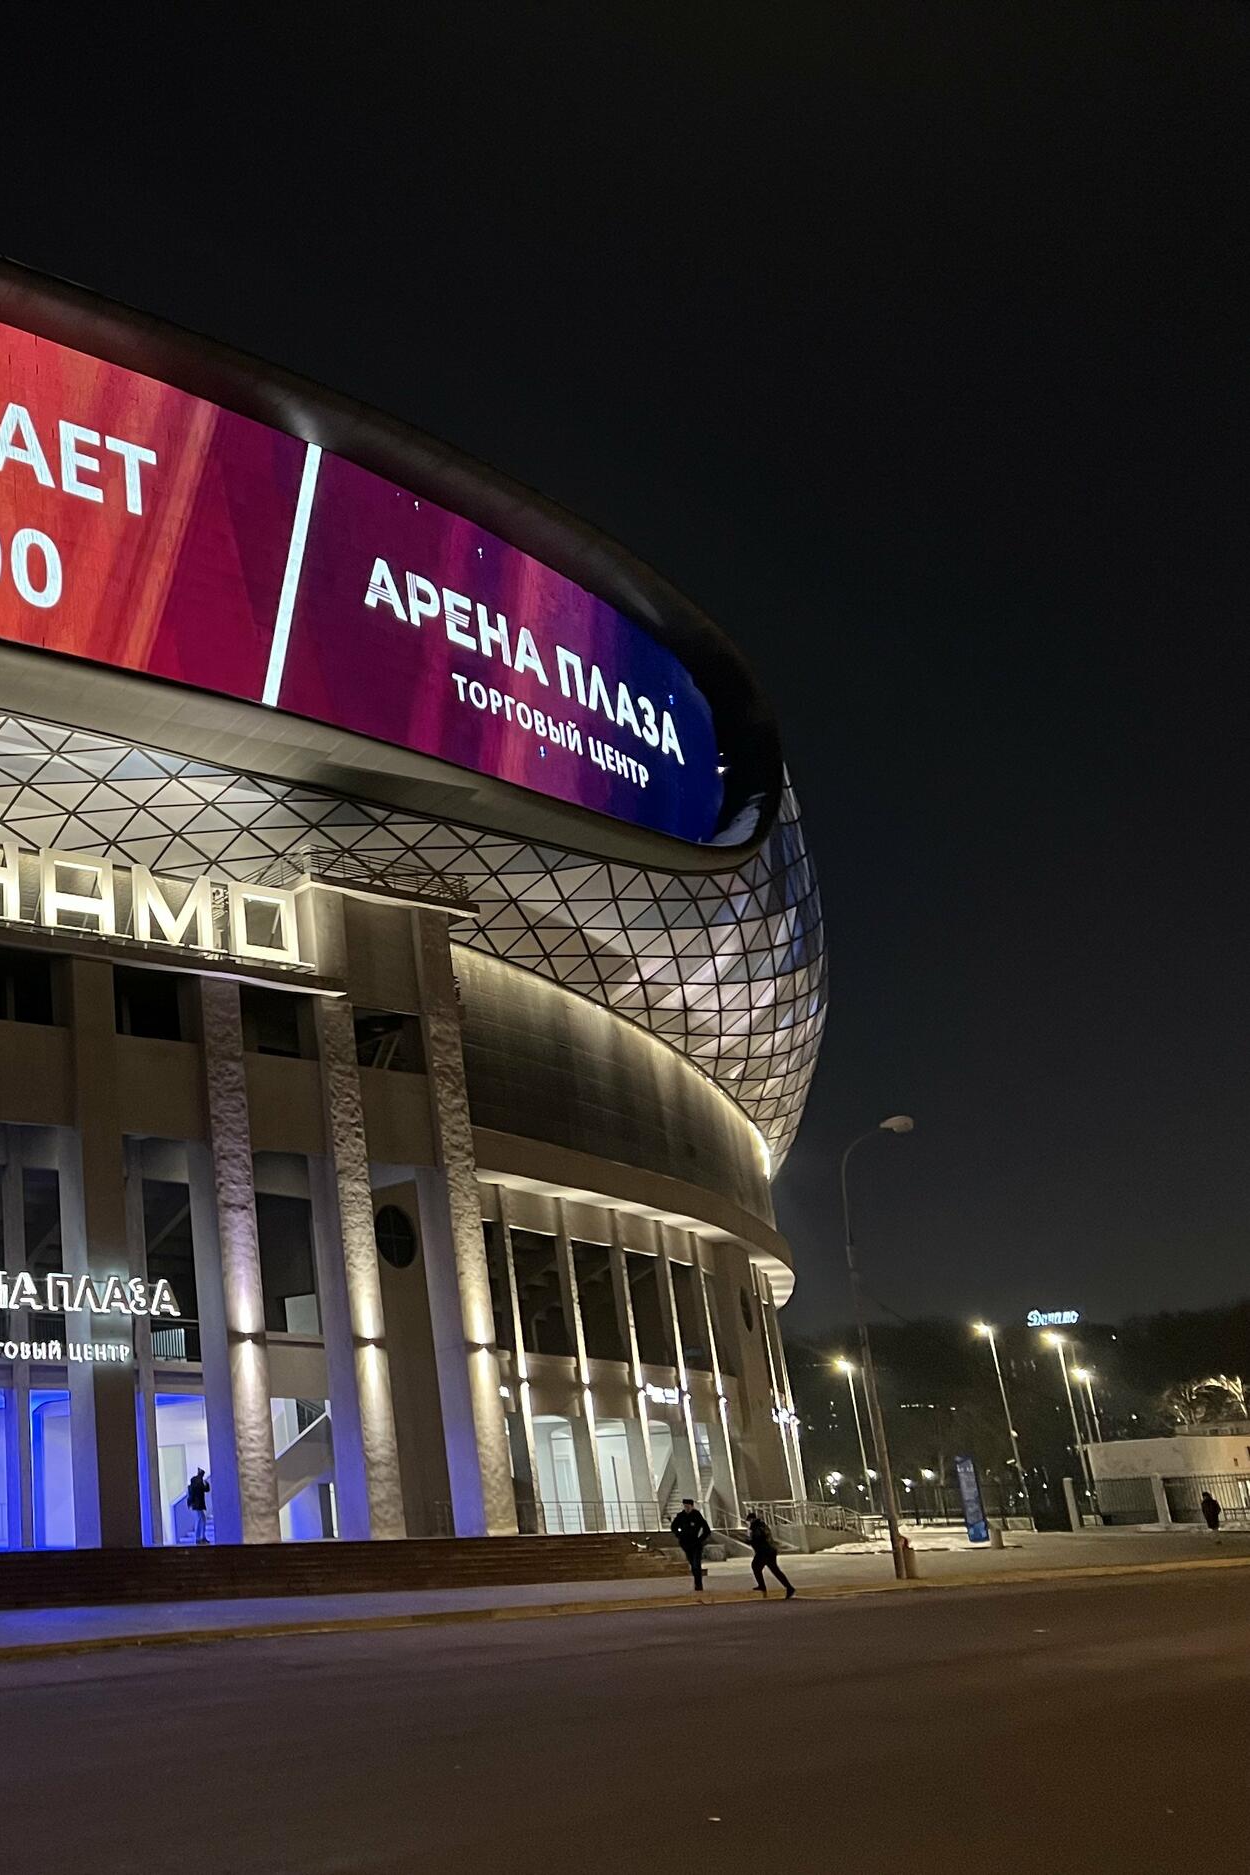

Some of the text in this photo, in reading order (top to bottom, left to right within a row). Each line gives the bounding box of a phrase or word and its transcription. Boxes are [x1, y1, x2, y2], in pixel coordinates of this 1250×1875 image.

[365, 557, 685, 765] АРЕНА ПЛАЗА
[451, 672, 649, 788] ТОРГОВЫЙ ЦЕНТР
[46, 1272, 181, 1317] ПЛАЗА
[68, 1342, 130, 1362] ЦЕНТР
